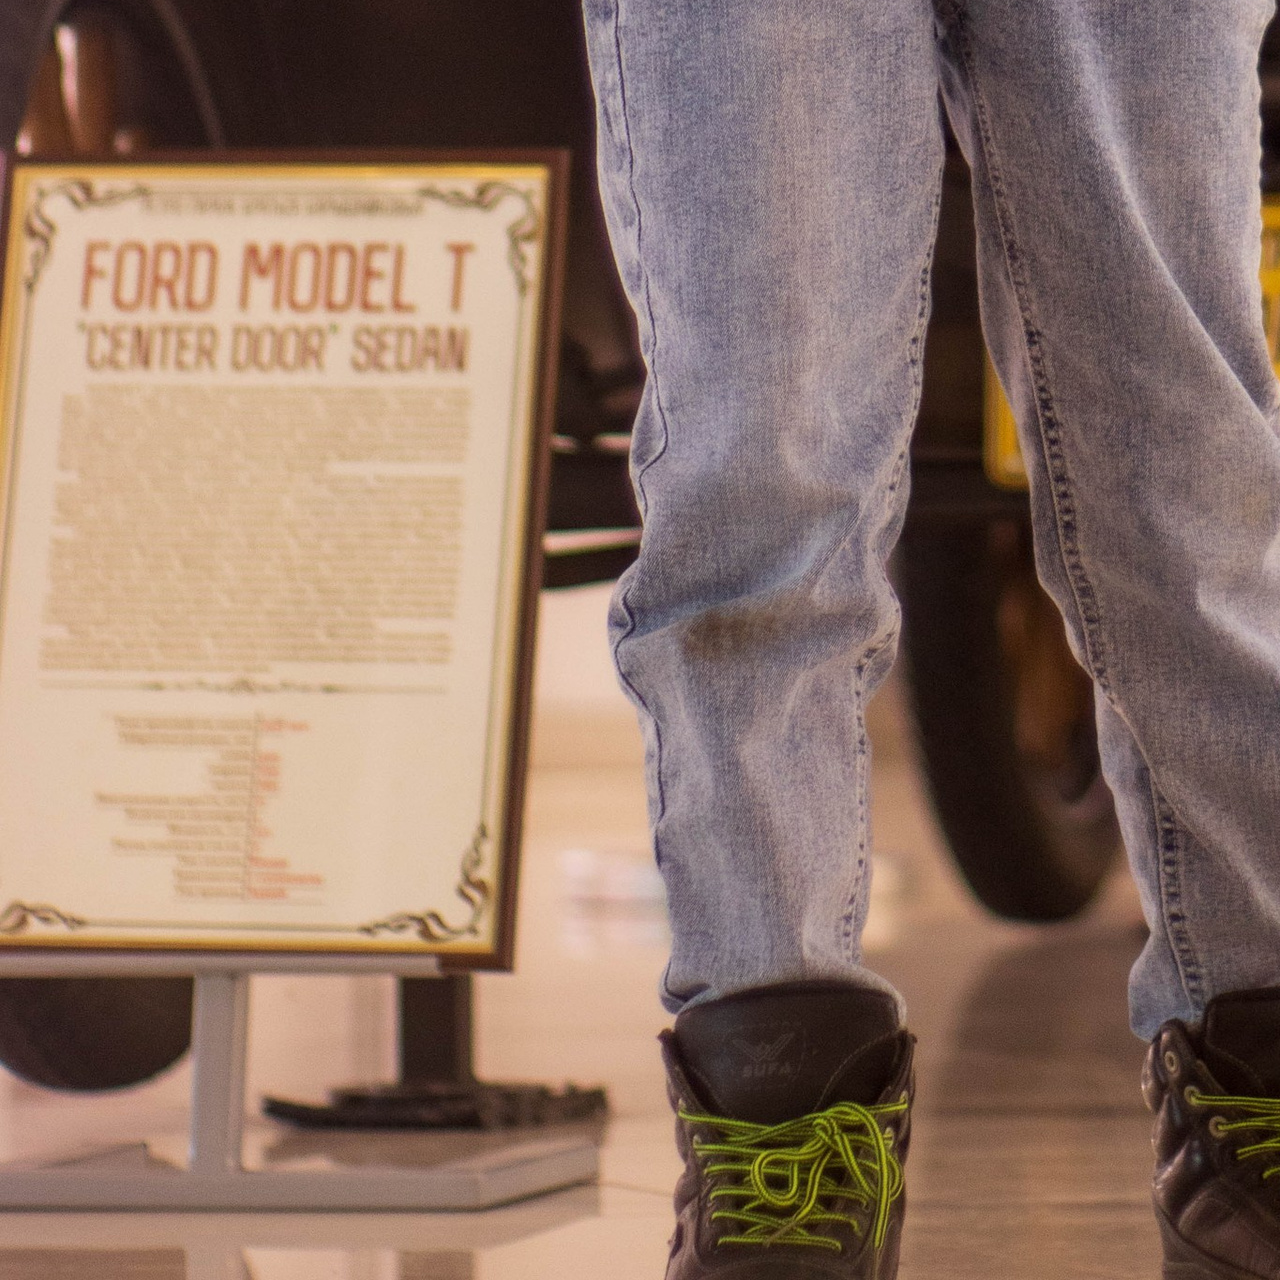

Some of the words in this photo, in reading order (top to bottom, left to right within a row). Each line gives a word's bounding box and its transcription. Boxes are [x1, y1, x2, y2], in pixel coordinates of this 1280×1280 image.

[81, 241, 219, 313] FORD
[238, 241, 418, 313] MODEL
[445, 241, 475, 313] T
[350, 322, 469, 373] SEDAN
